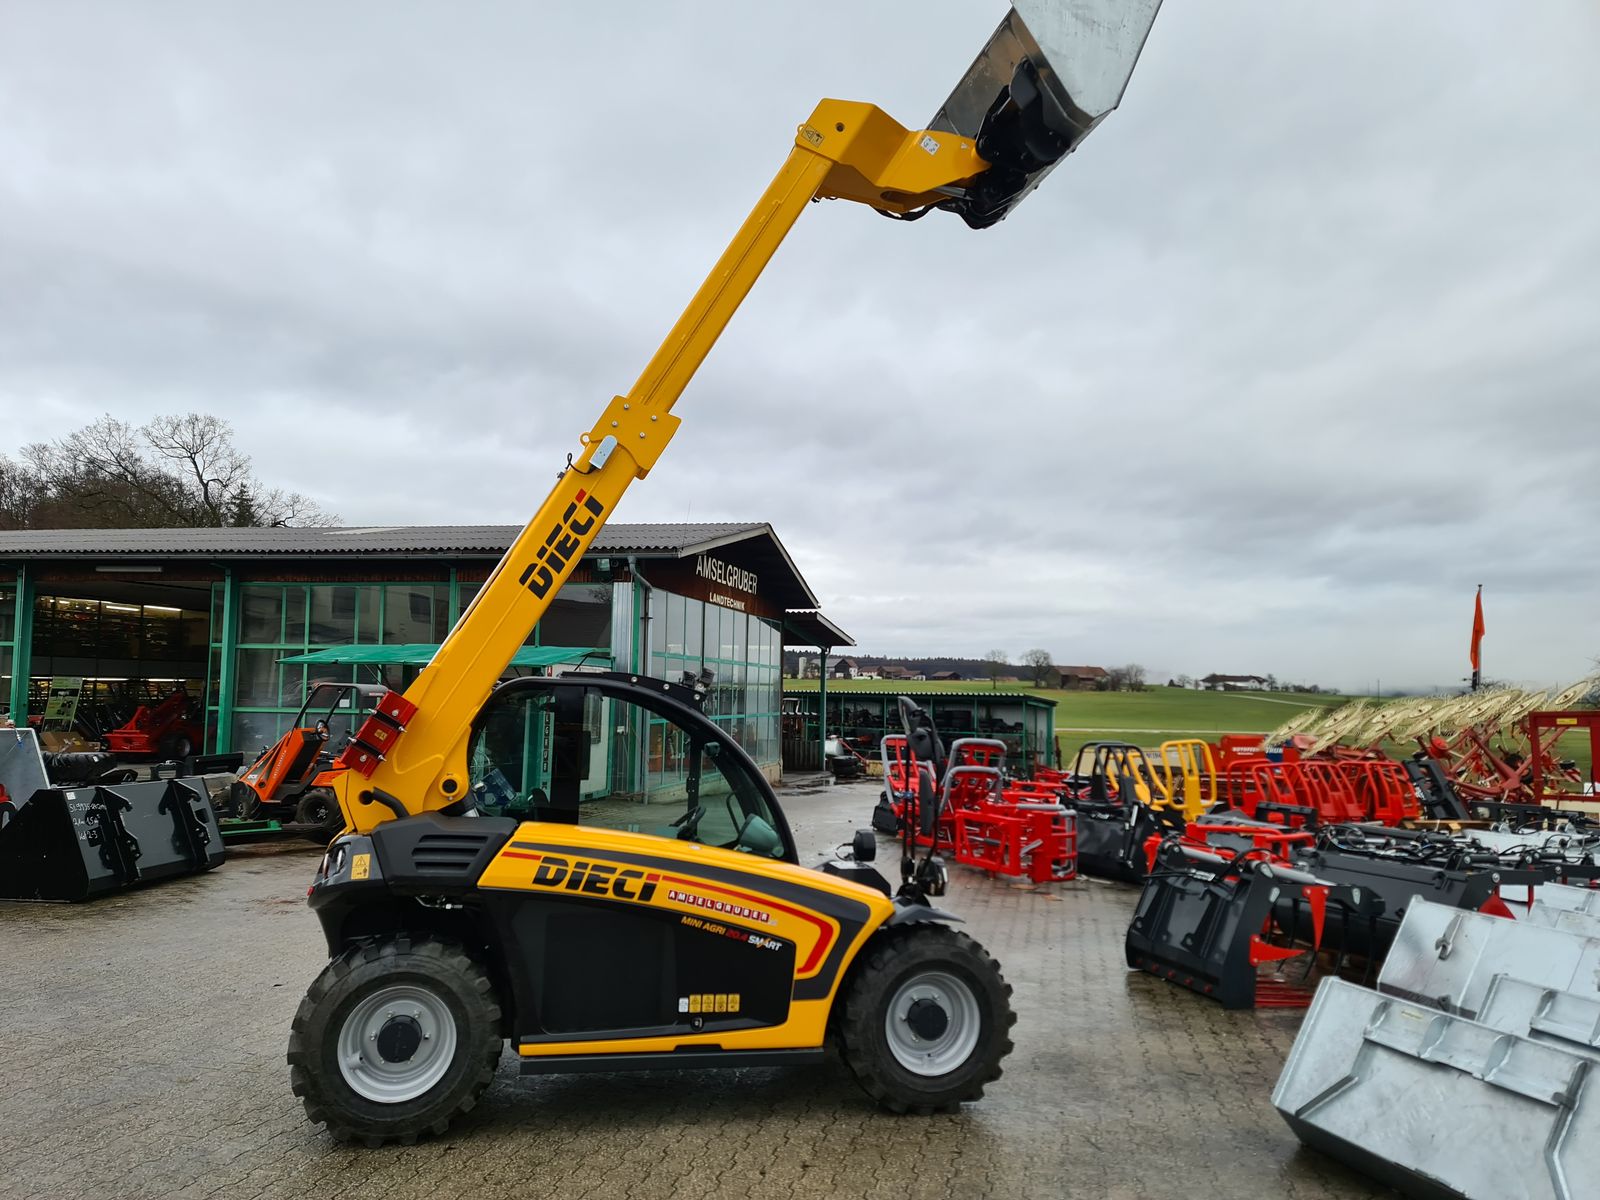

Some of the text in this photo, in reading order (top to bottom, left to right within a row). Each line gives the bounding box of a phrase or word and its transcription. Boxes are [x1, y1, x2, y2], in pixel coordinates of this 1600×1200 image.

[696, 555, 758, 595] AMSELGRUBER
[709, 592, 745, 610] LANDTECHNIK
[668, 890, 770, 922] AMSELGRUBER
[681, 916, 783, 952] MINI AGRI 20.4 SMART
